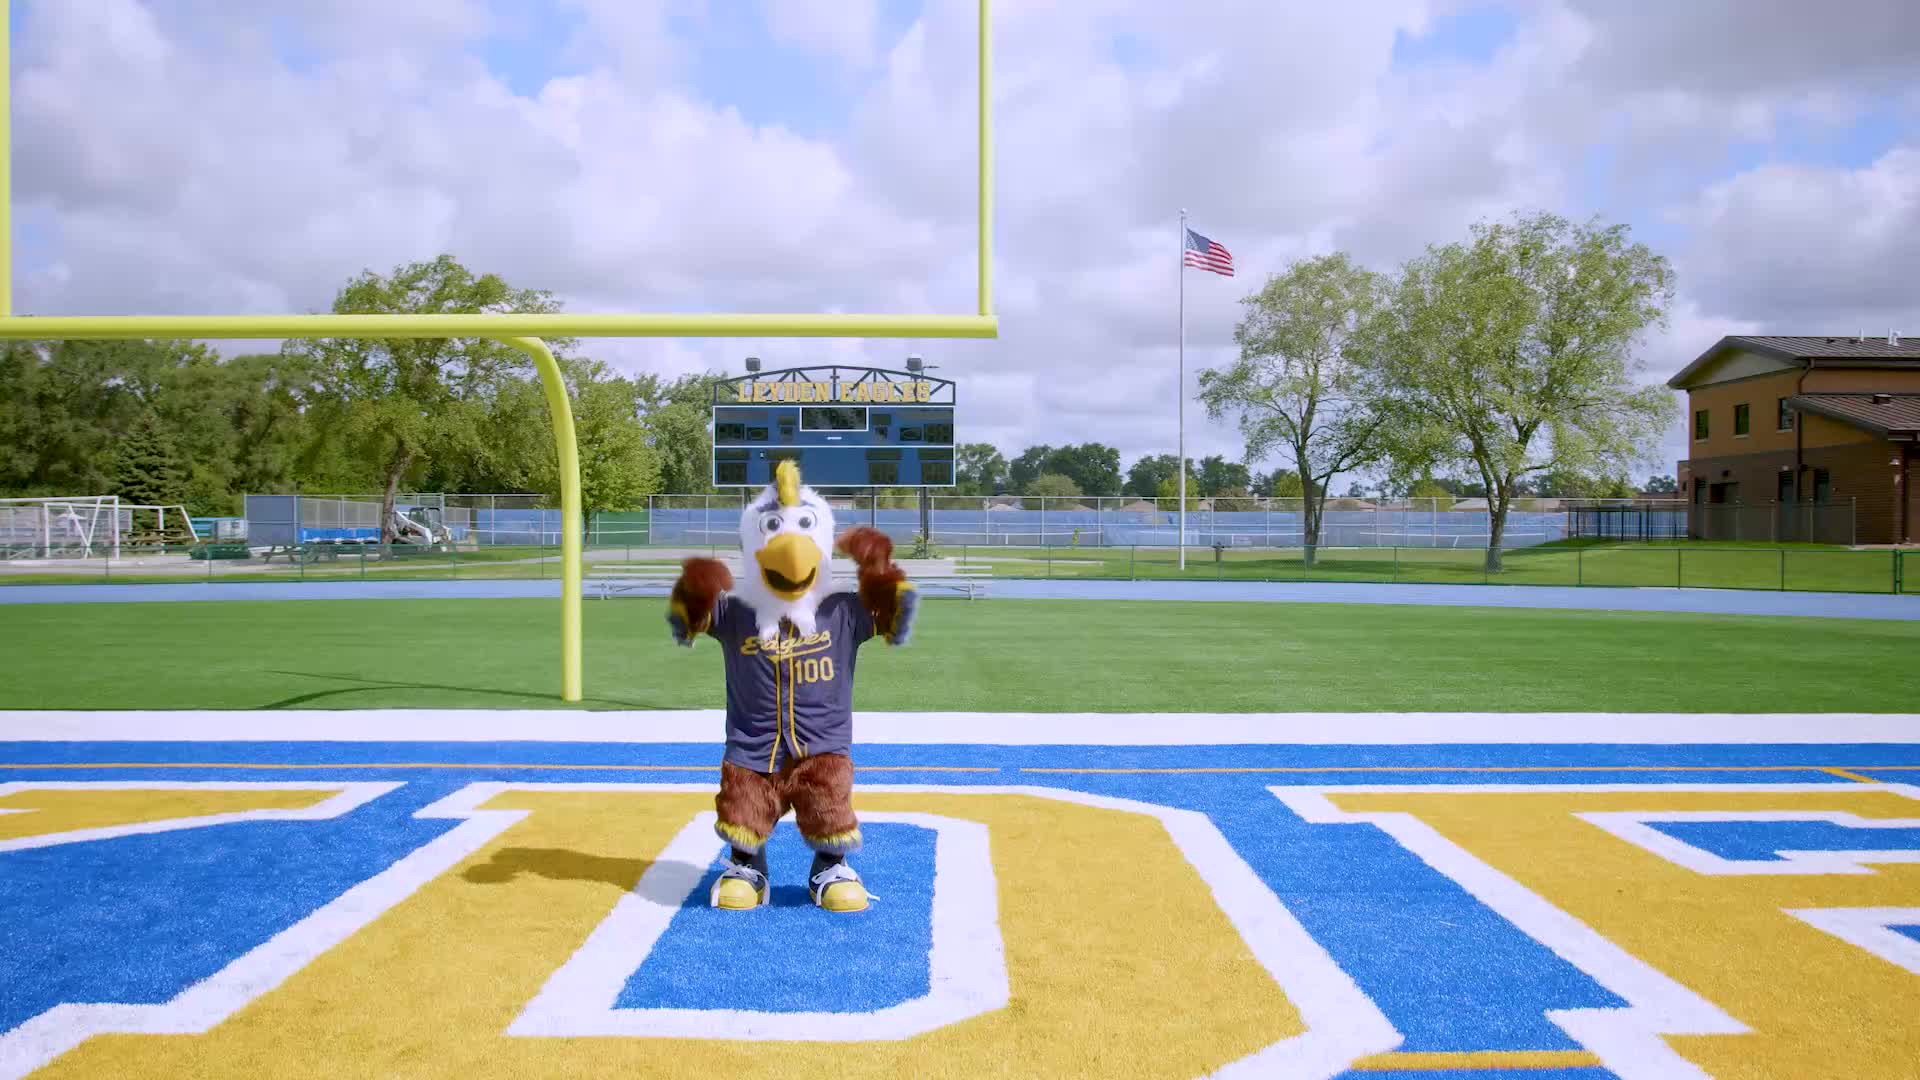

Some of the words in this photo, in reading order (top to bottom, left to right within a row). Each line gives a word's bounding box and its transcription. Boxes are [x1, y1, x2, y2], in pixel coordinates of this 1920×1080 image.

[737, 382, 832, 402] LEYDEN
[840, 382, 930, 402] EAGLES
[794, 656, 835, 684] 100
